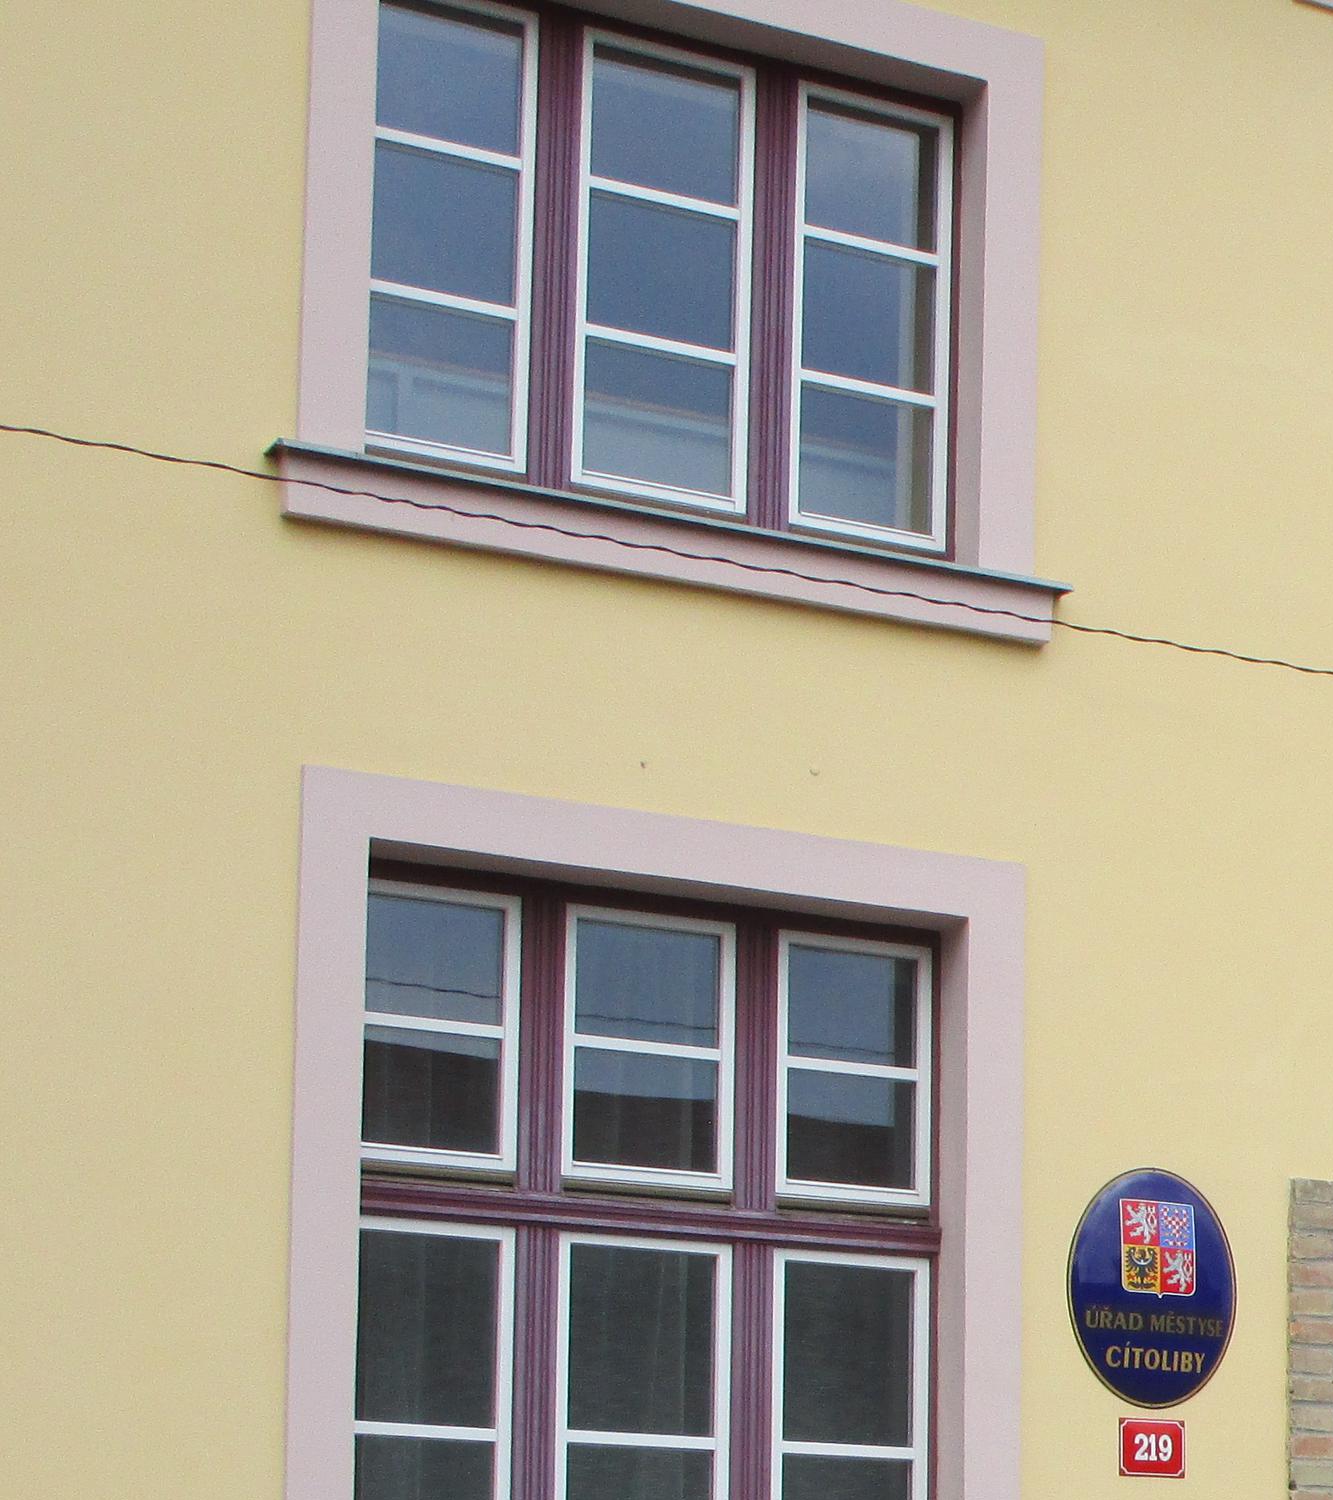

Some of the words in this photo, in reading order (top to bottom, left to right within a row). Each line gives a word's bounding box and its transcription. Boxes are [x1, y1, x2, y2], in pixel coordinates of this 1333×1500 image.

[1086, 1305, 1144, 1331] ÚŘAD
[1150, 1311, 1223, 1337] MĚSTYSE
[1105, 1341, 1205, 1373] CÍTOLIBY
[1134, 1433, 1172, 1462] 219
